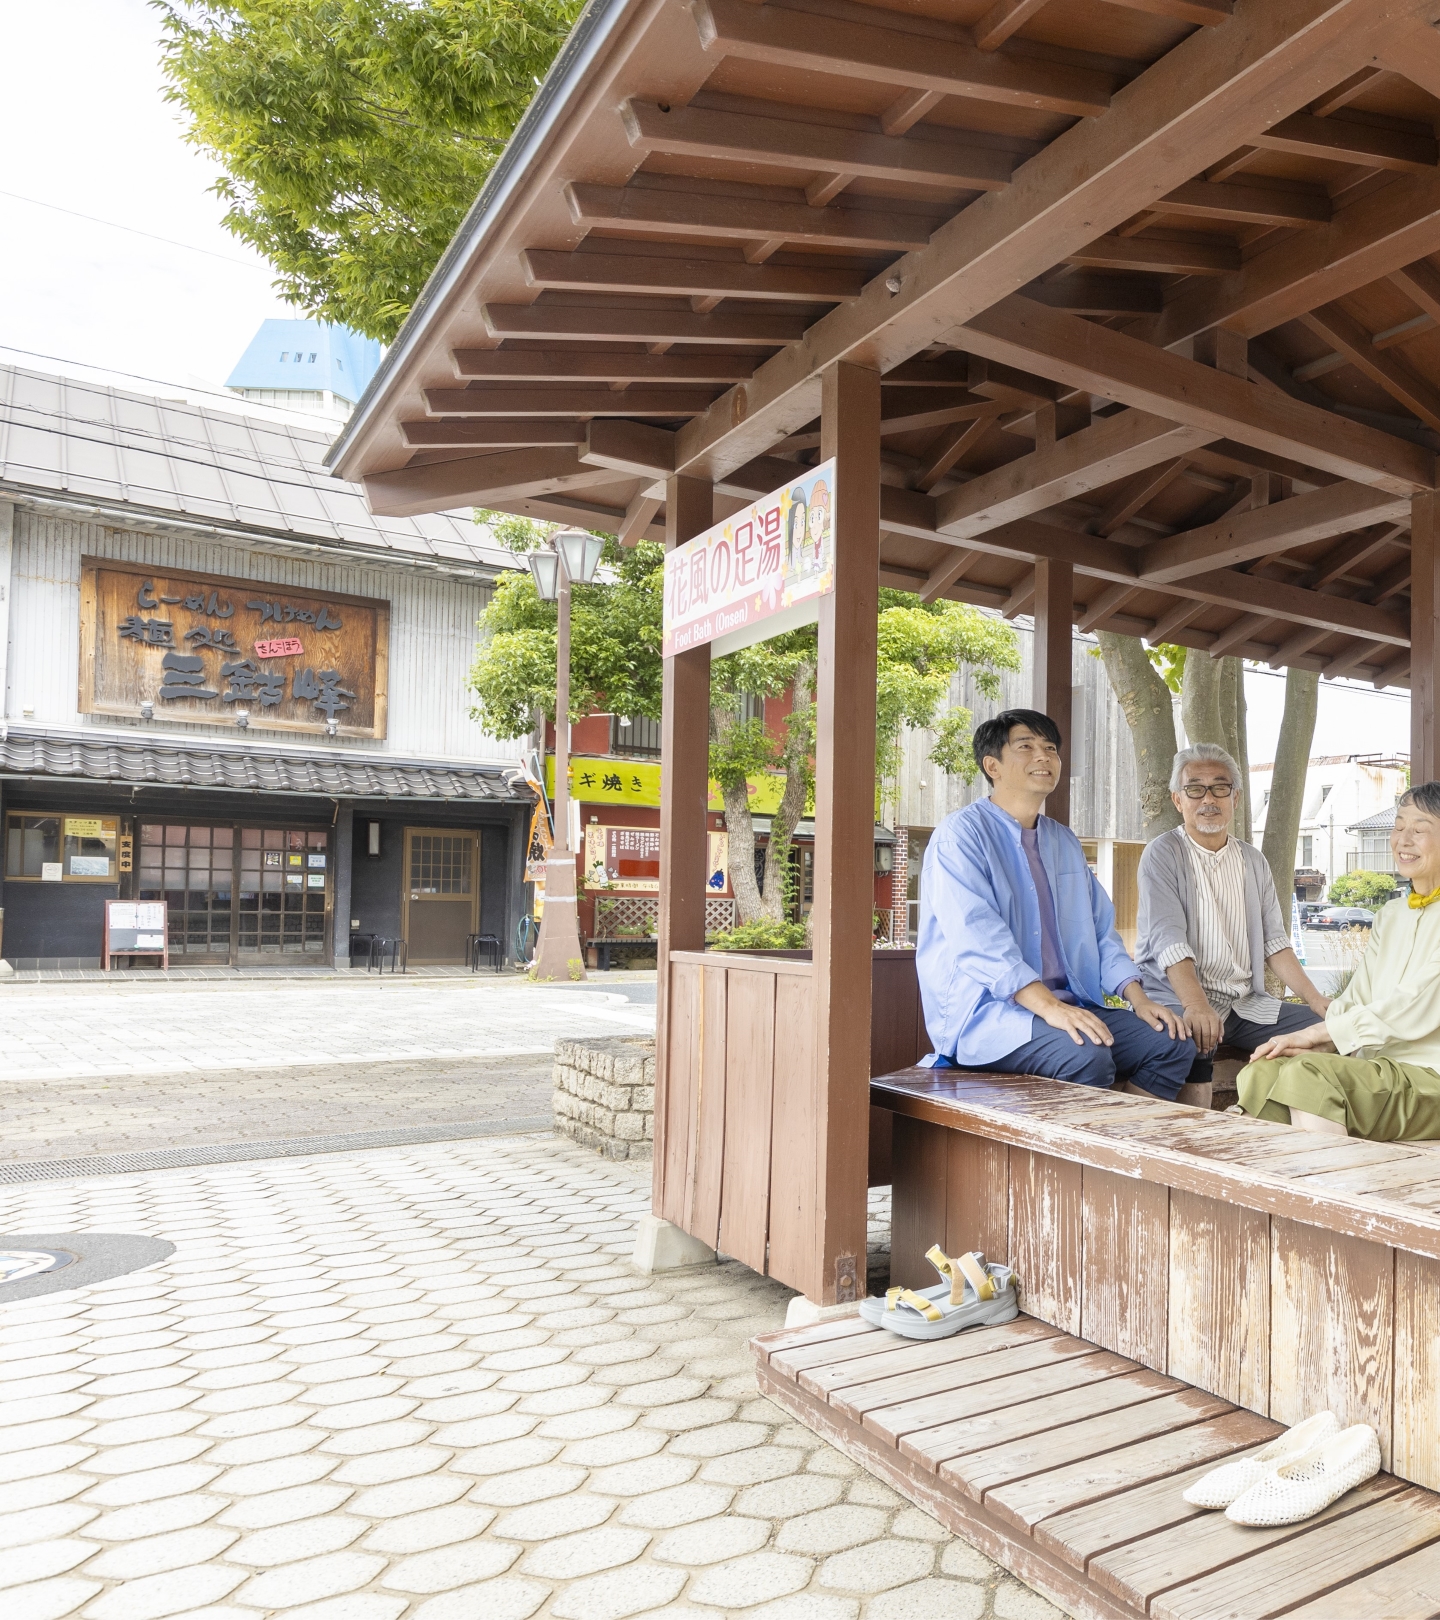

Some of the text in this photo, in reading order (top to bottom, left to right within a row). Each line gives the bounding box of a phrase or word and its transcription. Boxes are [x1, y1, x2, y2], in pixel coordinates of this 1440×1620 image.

[137, 581, 343, 631] らーめん つけめん
[117, 616, 241, 654] 麺処
[675, 602, 749, 649] Foot Bath (Onsen)
[553, 772, 643, 792] ギ焼き
[121, 841, 132, 868] 支度中
